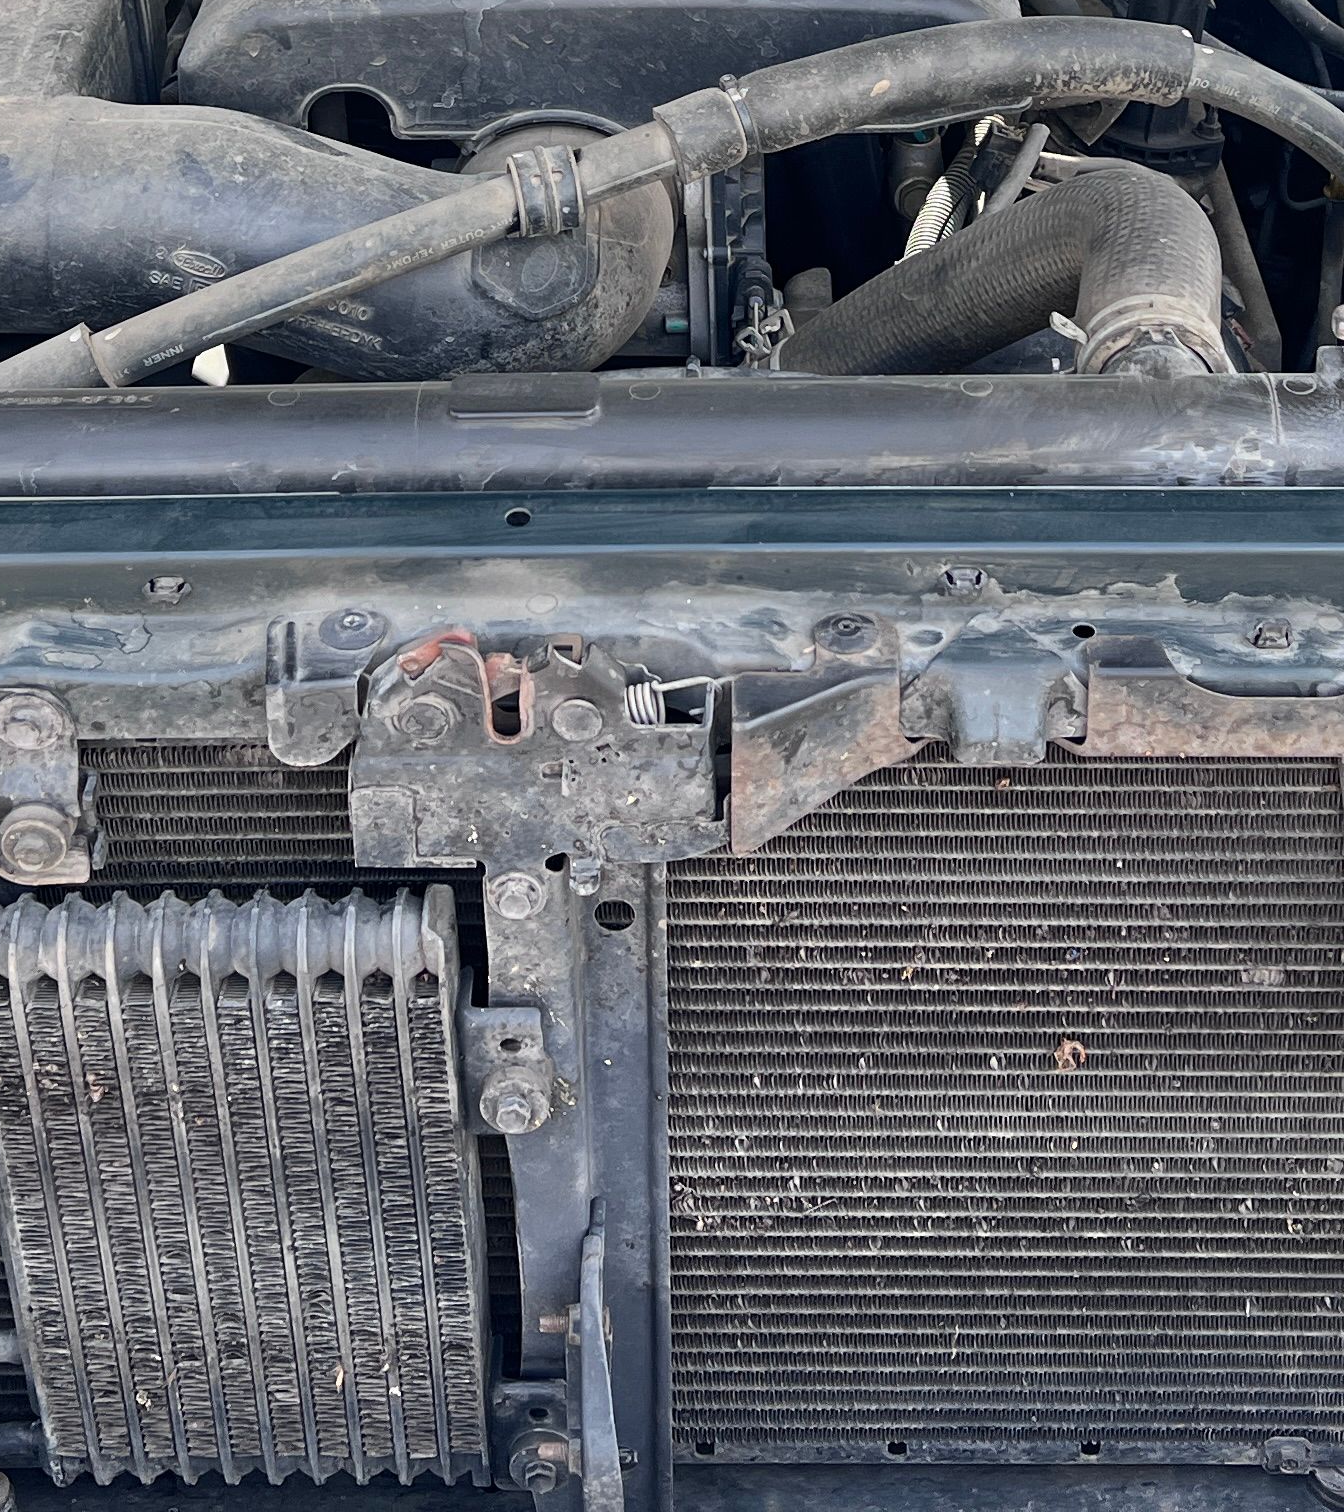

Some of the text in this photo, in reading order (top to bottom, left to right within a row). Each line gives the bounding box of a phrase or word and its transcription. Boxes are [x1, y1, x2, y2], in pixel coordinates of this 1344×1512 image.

[440, 226, 485, 253] OUTER
[149, 270, 184, 291] SAE
[143, 343, 185, 368] INNER
